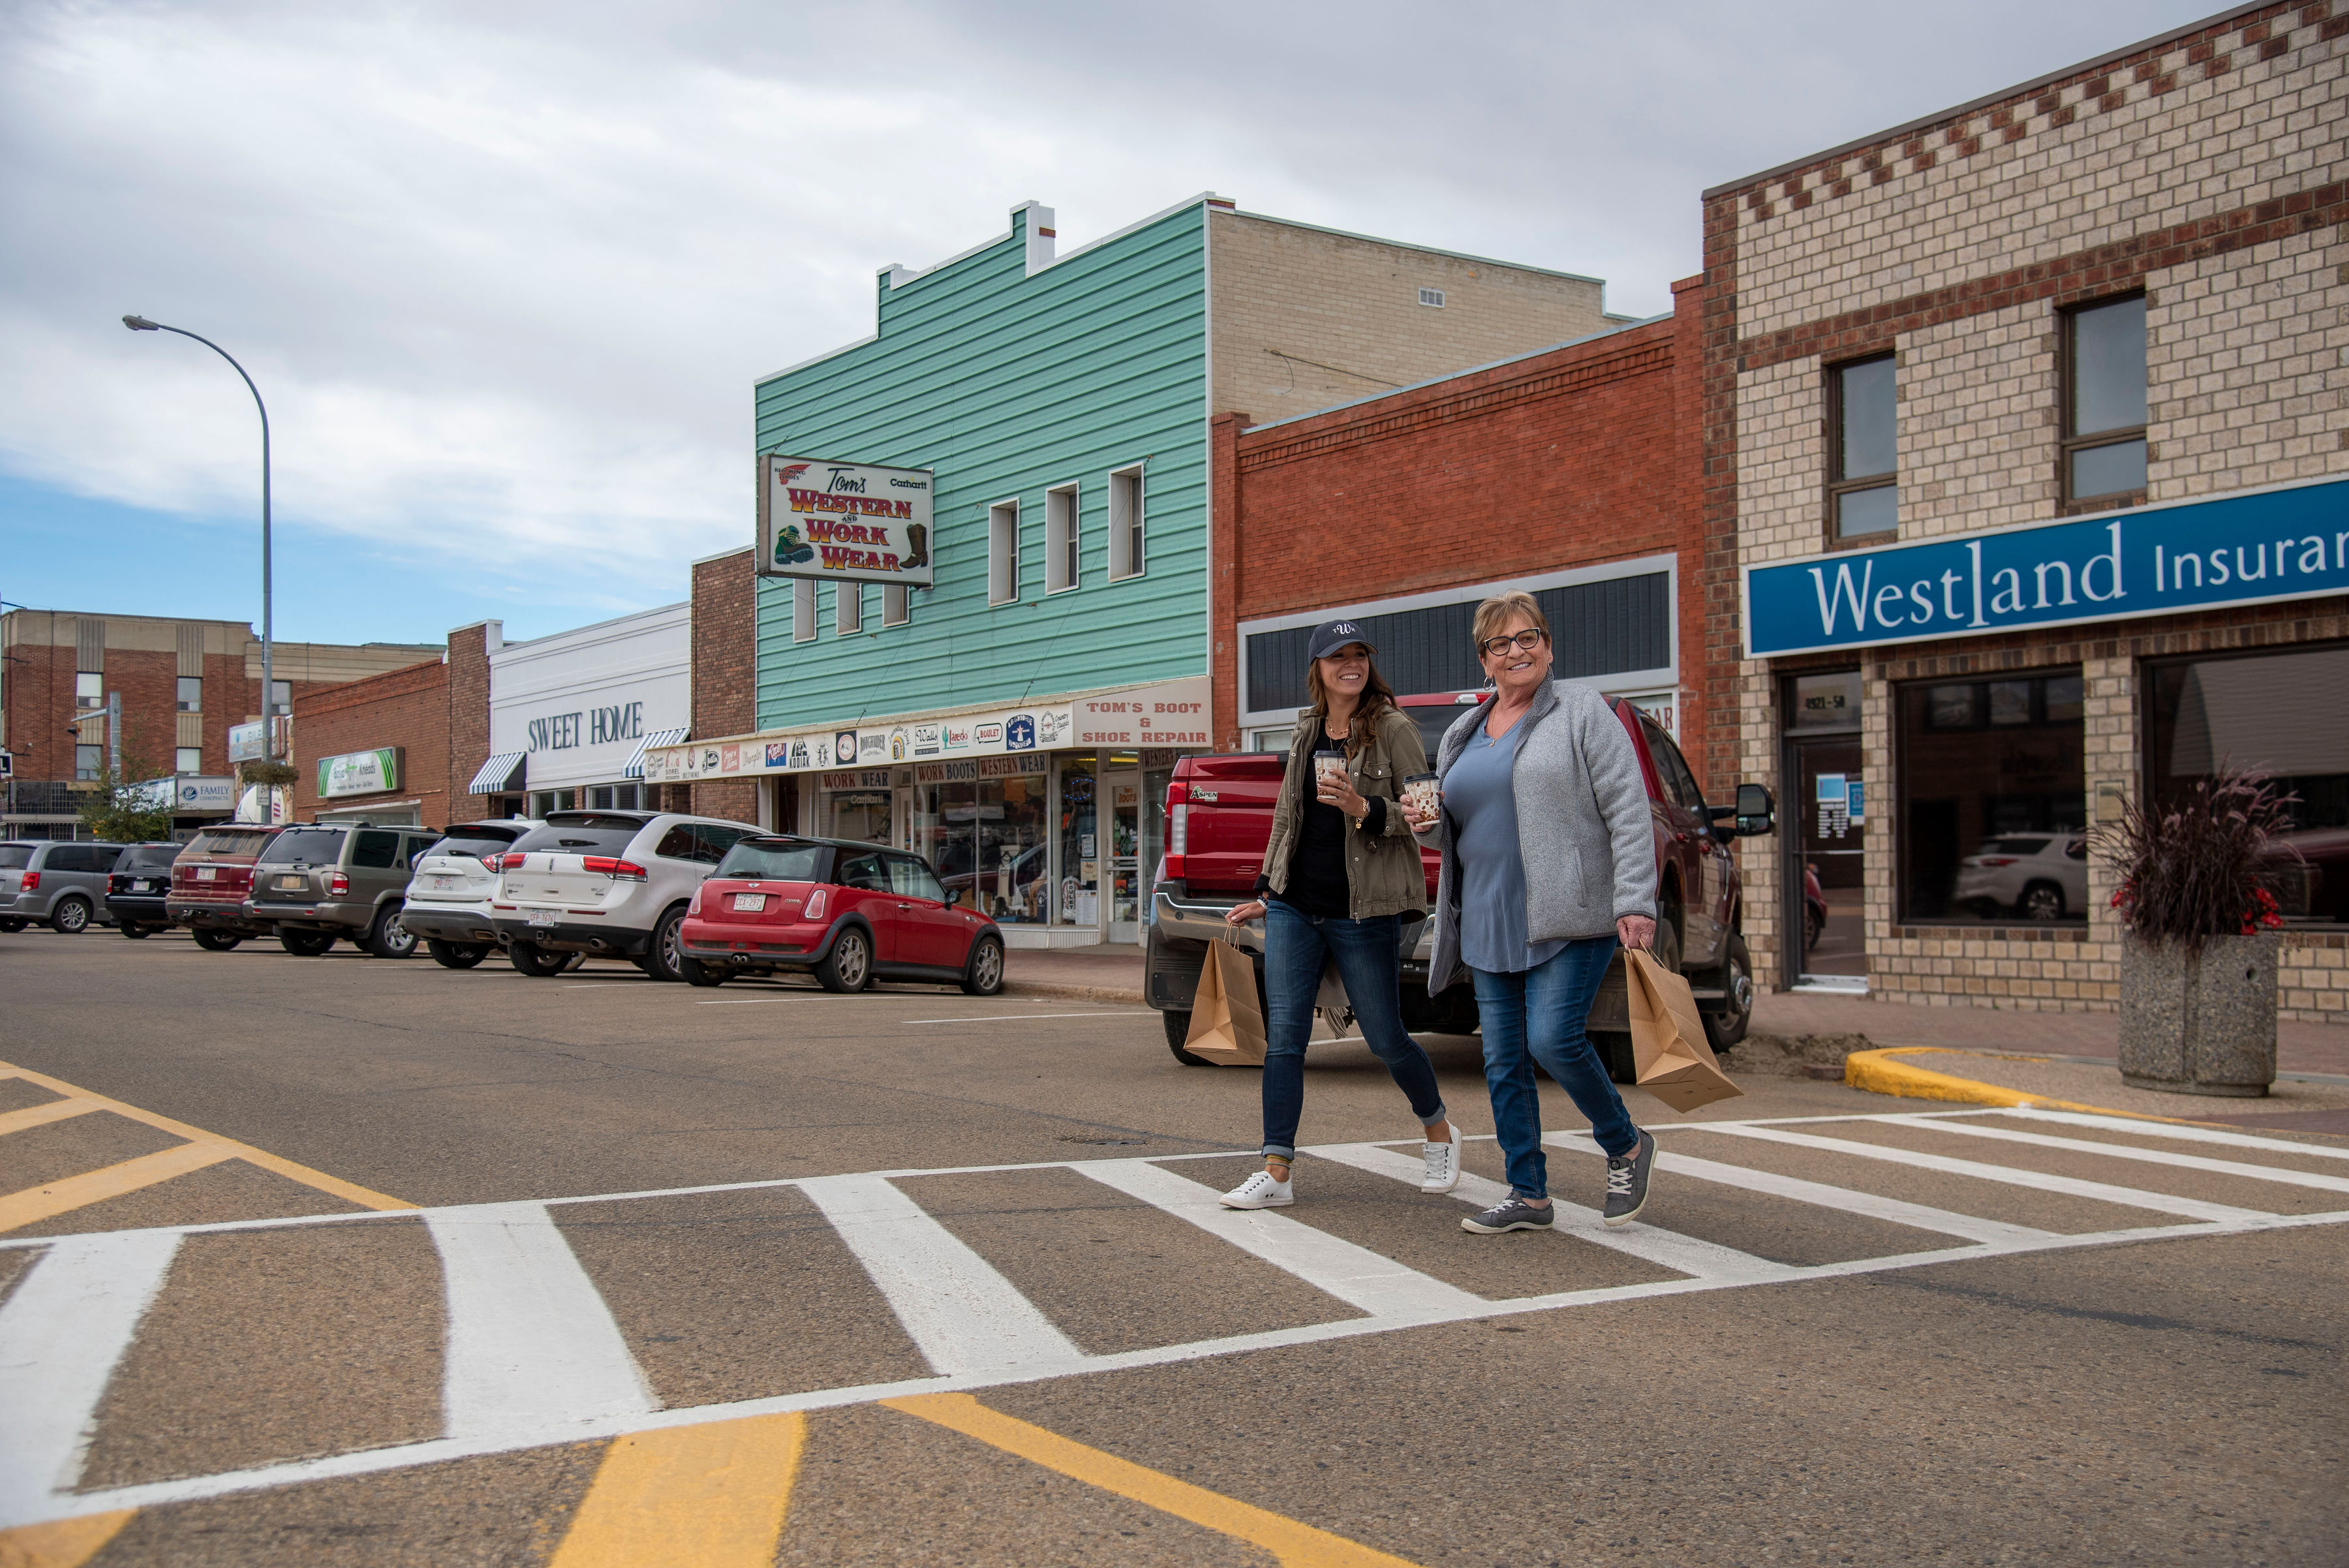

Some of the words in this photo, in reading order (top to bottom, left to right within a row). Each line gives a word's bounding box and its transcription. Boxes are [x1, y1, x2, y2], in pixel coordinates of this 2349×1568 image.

[827, 468, 867, 493] Tom's
[890, 478, 927, 489] Carhartt
[786, 487, 912, 519] WESTERN
[804, 518, 890, 546] WORK
[819, 545, 902, 572] WEAR
[1807, 521, 2126, 636] Westland
[1086, 703, 1143, 713] TOM'S
[1154, 703, 1201, 713] BOOT
[528, 712, 583, 752] SWEET
[590, 701, 643, 745] HOME
[1140, 717, 1151, 728] &
[1644, 707, 1672, 730] AR
[916, 730, 938, 742] Walls
[949, 728, 968, 745] Laredo
[980, 729, 1000, 738] BOULET
[1082, 732, 1130, 743] SHOE
[1141, 732, 1206, 743] REPAIR
[860, 735, 885, 753] ROUGHRIDER
[790, 757, 810, 769] KODIAK
[980, 757, 1018, 775] WESTERN
[1019, 754, 1045, 773] WEAR
[1144, 748, 1174, 767] WESTERN
[823, 773, 856, 788] WORK
[861, 772, 888, 787] WEAR
[918, 765, 945, 782] WORK
[946, 762, 975, 780] BOOTS
[200, 786, 230, 795] FAMILY
[1118, 793, 1137, 804] BOOTS
[1191, 790, 1218, 798] ASPEN
[736, 898, 763, 907] CCX-2971
